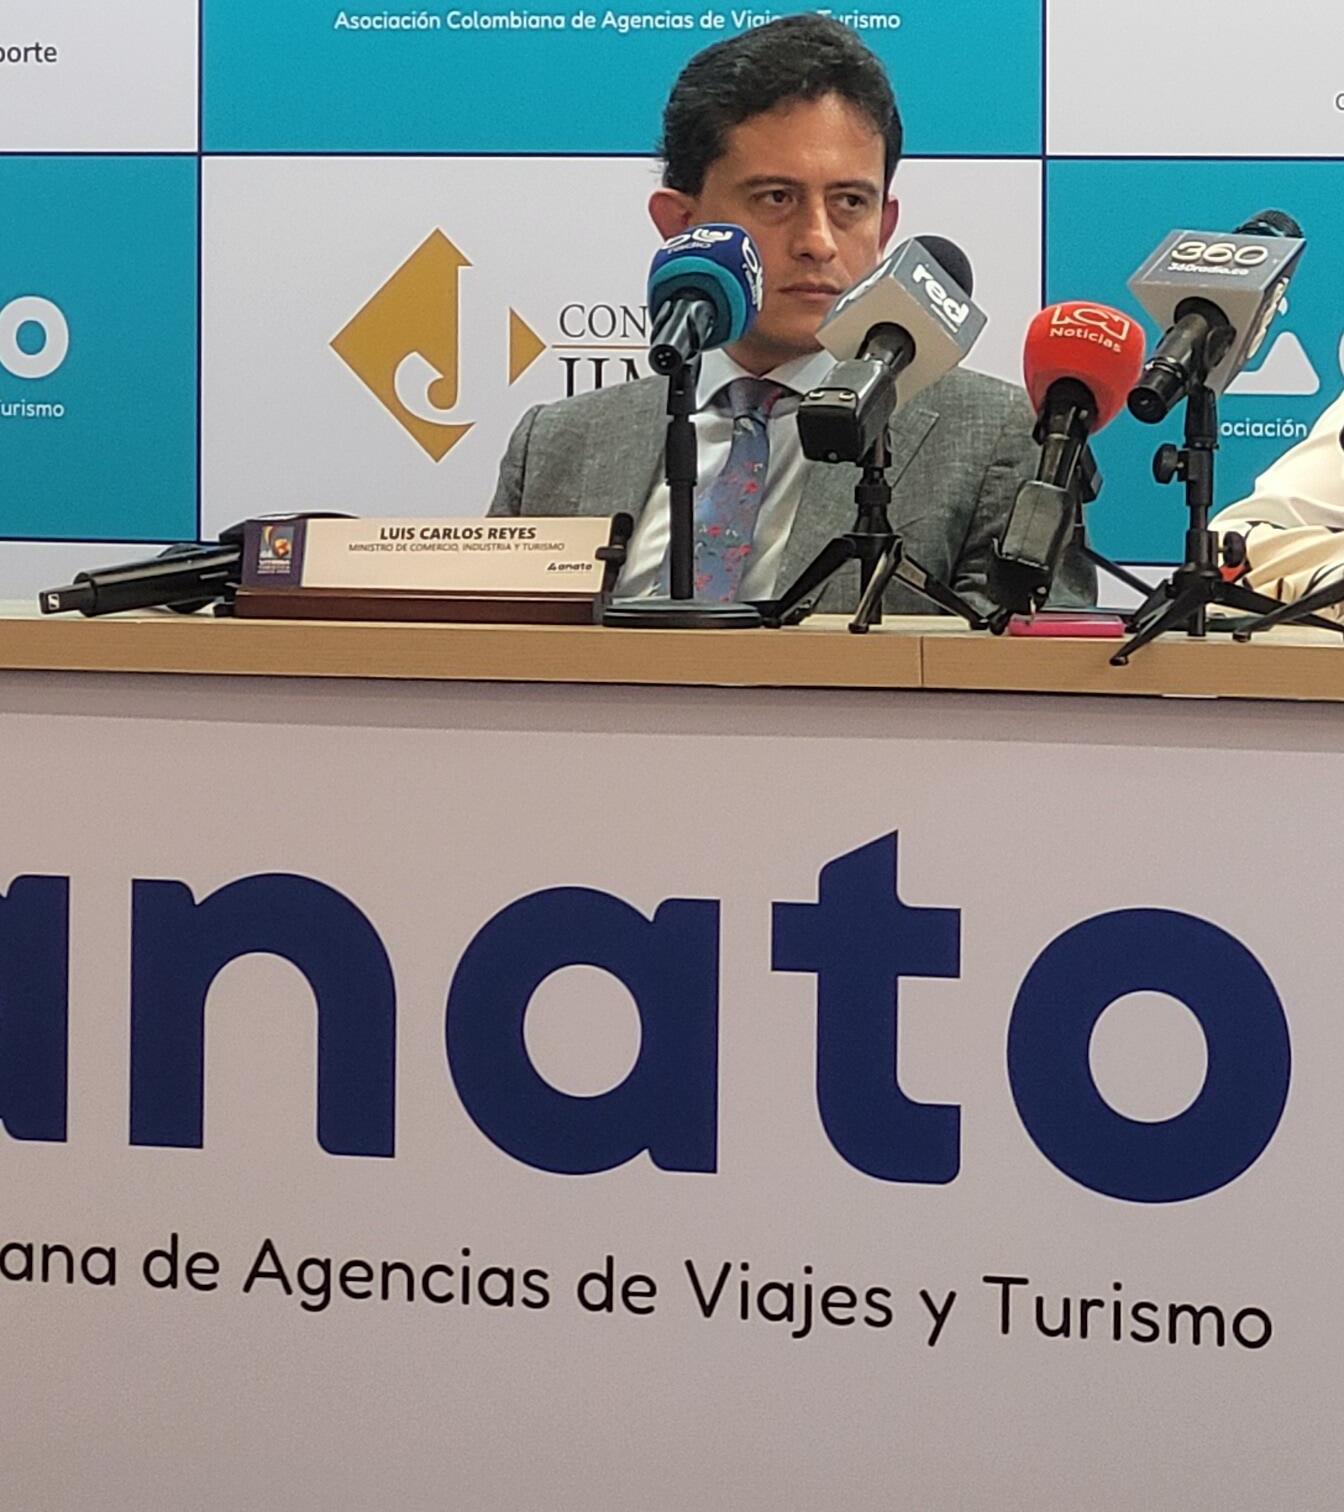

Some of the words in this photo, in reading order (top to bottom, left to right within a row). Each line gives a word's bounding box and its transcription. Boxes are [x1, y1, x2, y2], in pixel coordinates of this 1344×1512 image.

[334, 11, 441, 29] Asociación
[446, 10, 566, 29] Colombiana
[571, 10, 597, 29] de
[601, 10, 694, 33] Agencias
[699, 10, 725, 29] de
[1171, 240, 1269, 266] 360
[1049, 326, 1122, 353] Noticias
[380, 527, 416, 541] LUIS
[419, 527, 483, 540] CARLOS
[487, 527, 537, 540] REYES
[348, 543, 394, 552] MINISTRO
[395, 542, 408, 552] DE
[462, 542, 512, 552] INDUSTRIA
[522, 542, 565, 551] TURISMO
[142, 1232, 220, 1292] de
[242, 1238, 550, 1313] Agencias
[577, 1255, 657, 1315] de
[684, 1259, 893, 1334] Viajes
[919, 1289, 957, 1340] y
[982, 1275, 1272, 1349] Turismo
